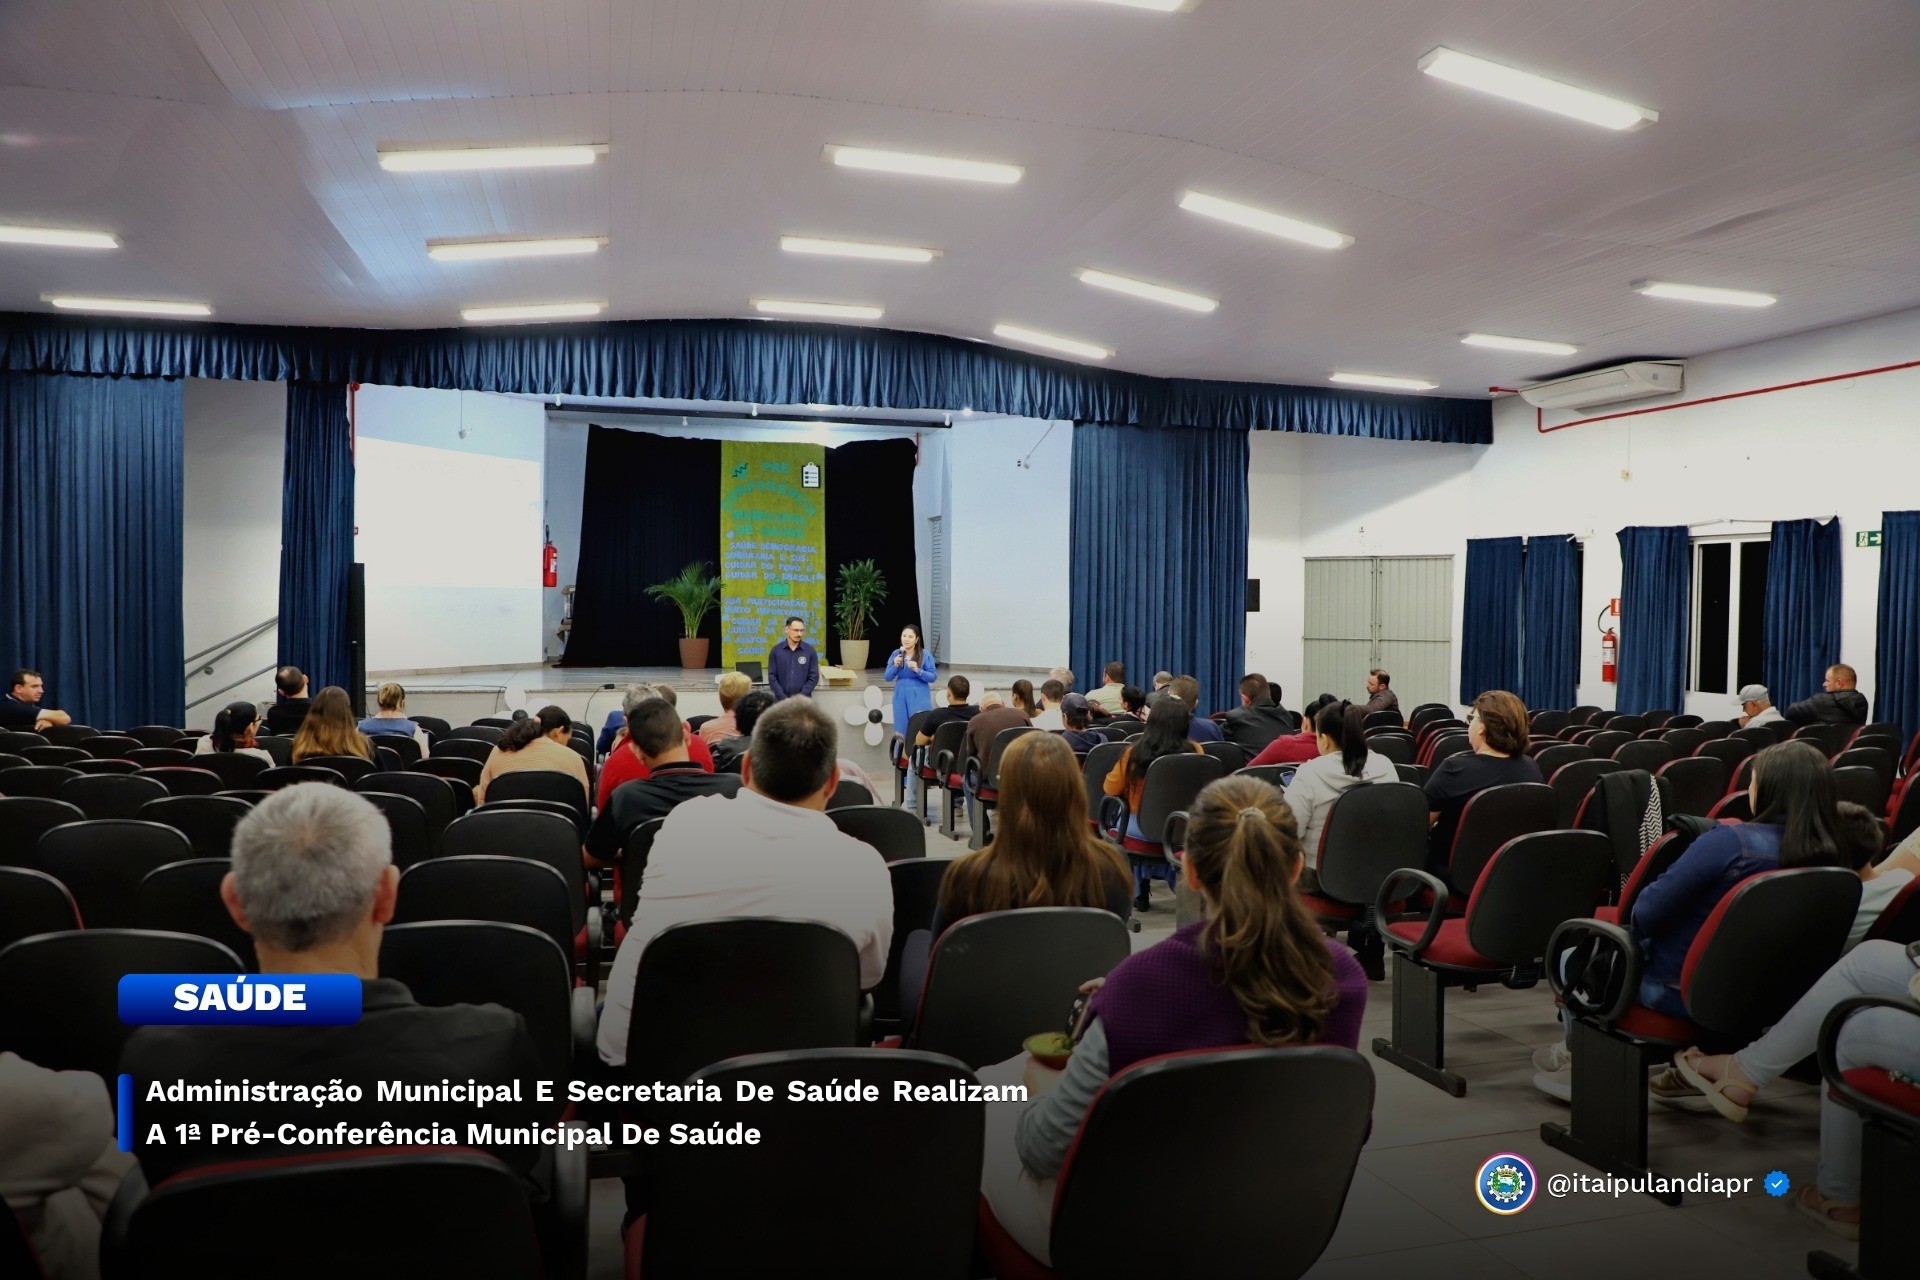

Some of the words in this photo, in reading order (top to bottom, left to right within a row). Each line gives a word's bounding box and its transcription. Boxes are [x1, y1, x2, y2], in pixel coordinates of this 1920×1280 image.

[725, 561, 757, 569] CUIDAR
[779, 564, 801, 572] POVO
[725, 571, 758, 579] CUIDAR
